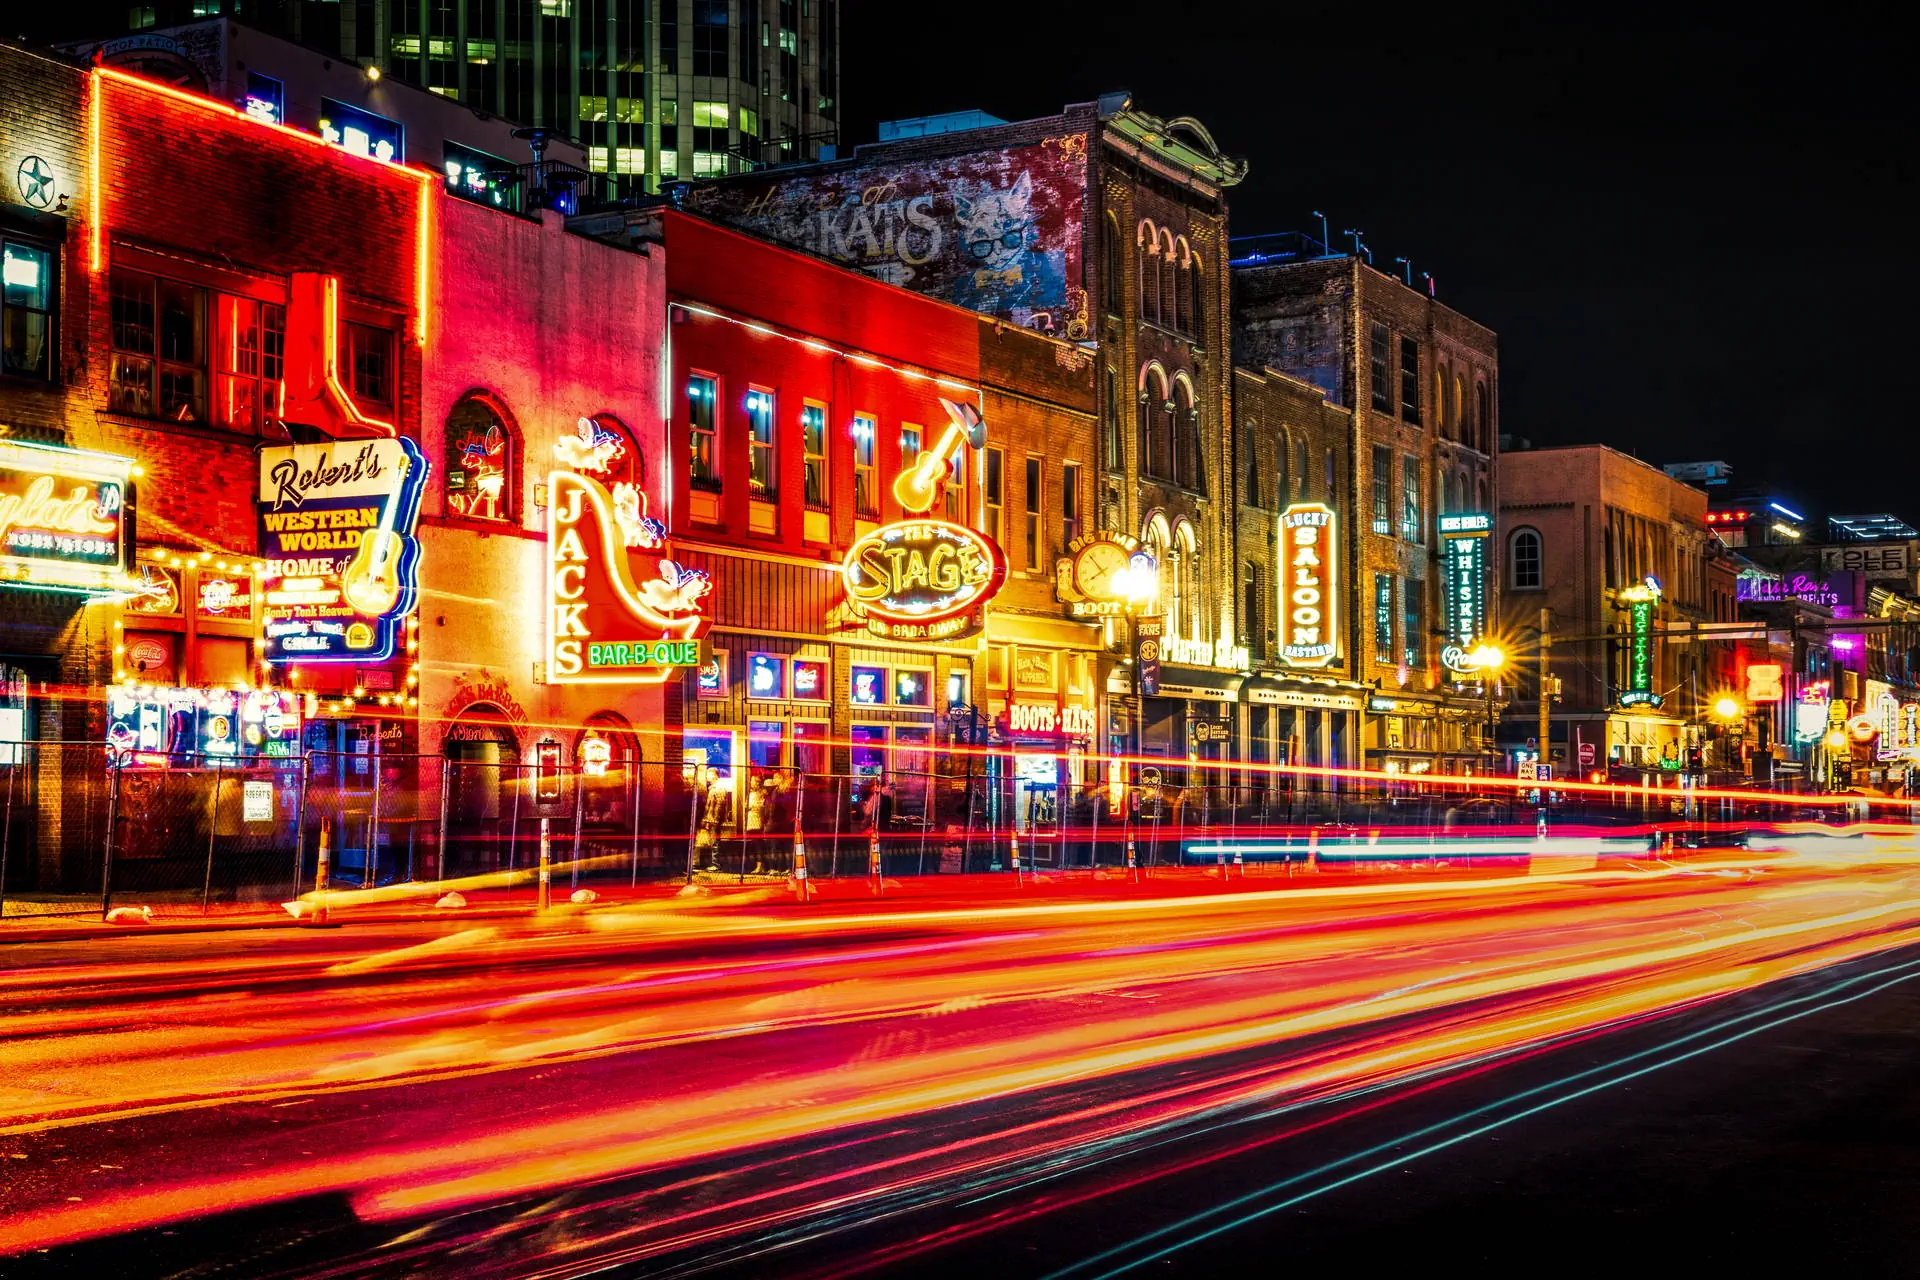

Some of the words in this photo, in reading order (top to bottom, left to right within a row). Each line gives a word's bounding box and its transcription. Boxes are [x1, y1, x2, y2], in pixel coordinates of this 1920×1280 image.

[818, 196, 942, 265] KATS
[271, 444, 382, 511] Robert's
[264, 508, 379, 531] WESTERN
[1285, 513, 1329, 528] LUCKY
[278, 531, 361, 551] WORLD
[903, 526, 932, 540] THE
[1069, 533, 1096, 552] BIG
[1099, 530, 1138, 550] TIME
[1843, 549, 1903, 562] OLE
[266, 558, 334, 577] HOME
[852, 541, 986, 600] STAGE
[554, 489, 591, 674] JACKS
[1293, 527, 1320, 645] SALOON
[1455, 540, 1474, 648] WHISKEY
[264, 605, 293, 620] Honky
[294, 604, 317, 617] Tonk
[318, 605, 354, 617] Heaven
[869, 619, 886, 635] ON
[893, 616, 967, 637] BROADWAY
[1138, 627, 1160, 636] FANS
[588, 643, 698, 665] BAR-B-QUE
[1010, 706, 1054, 732] BOOTS
[1062, 708, 1095, 734] HATS
[268, 742, 290, 757] ATM
